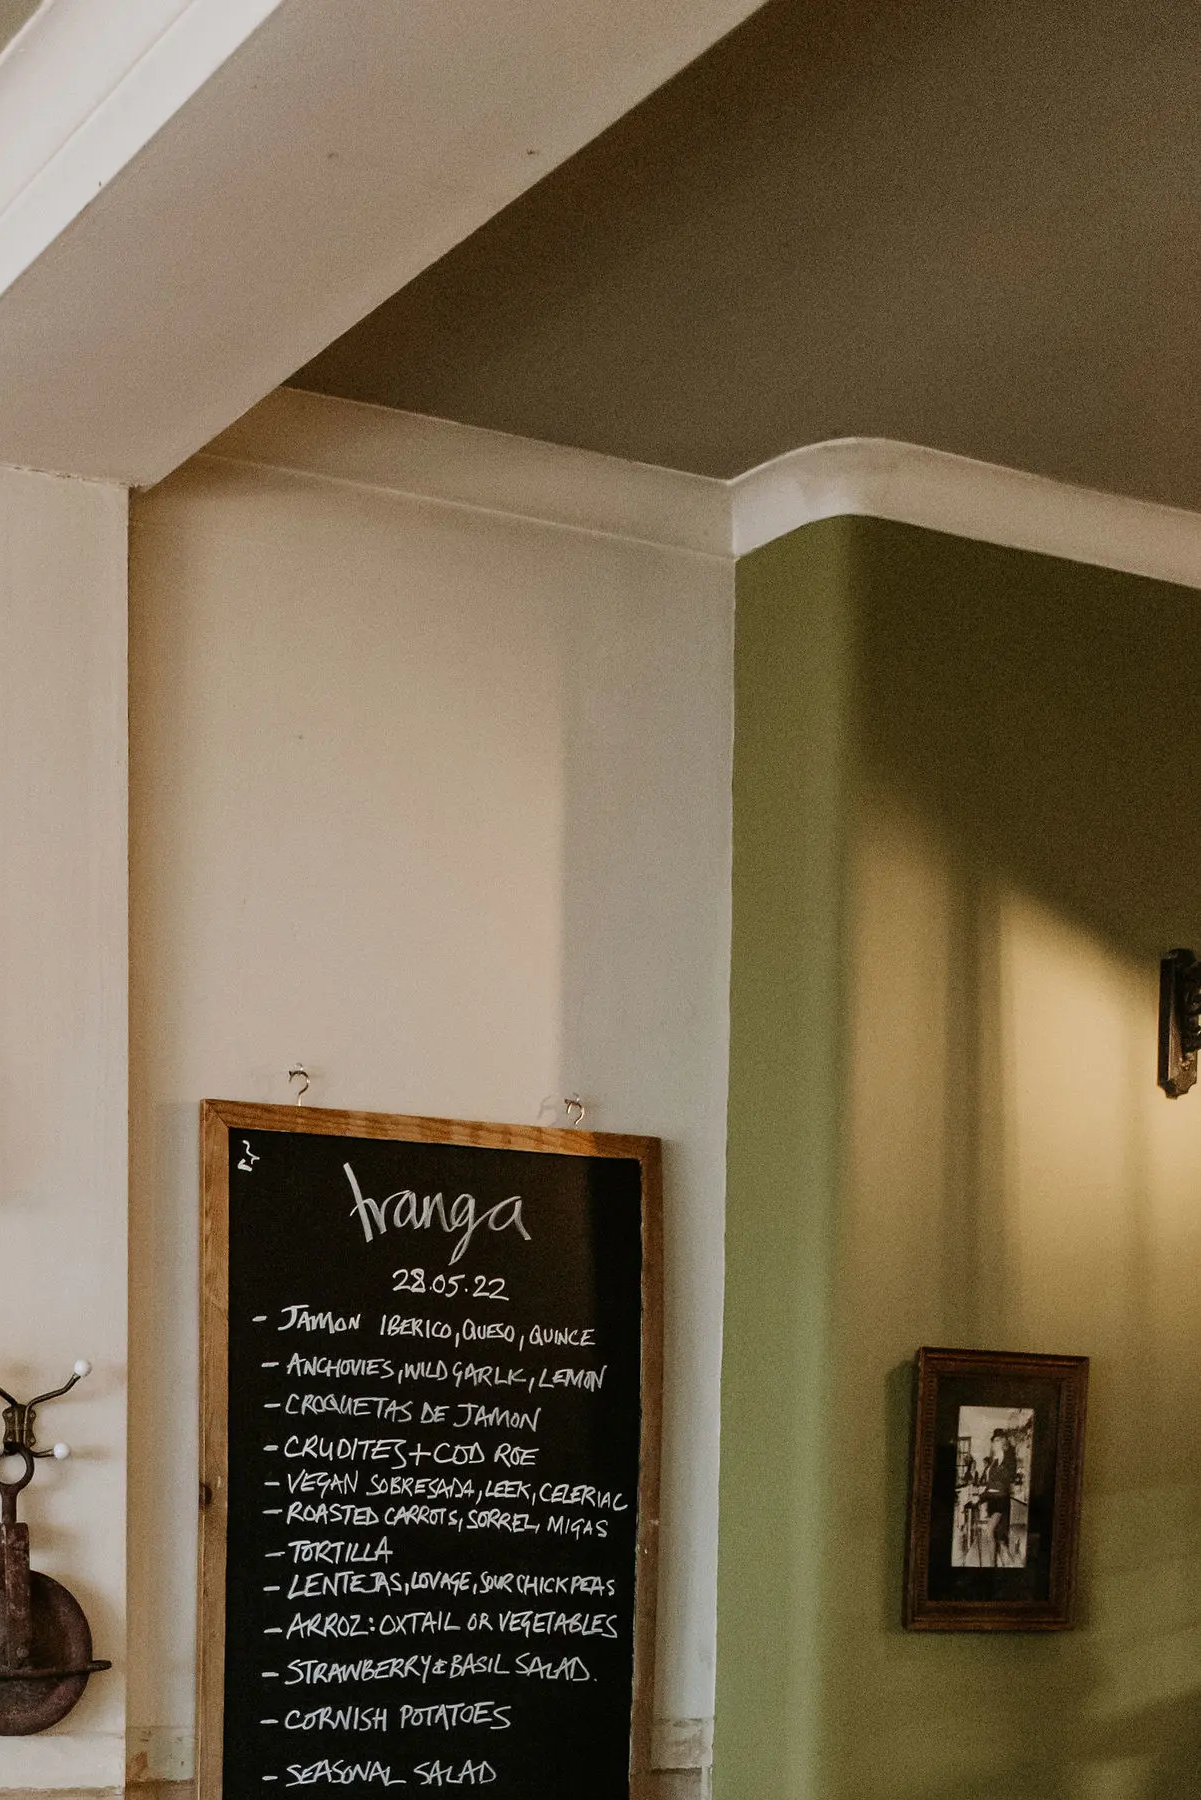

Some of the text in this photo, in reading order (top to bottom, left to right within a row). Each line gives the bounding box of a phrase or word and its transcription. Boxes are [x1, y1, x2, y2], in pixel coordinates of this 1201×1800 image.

[392, 1268, 509, 1300] 28.05.22
[278, 1304, 361, 1334] JAMON
[529, 1324, 596, 1346] QUINCE
[404, 1360, 448, 1381] WILD
[538, 1364, 607, 1392] LEMON
[285, 1393, 541, 1432] CROQUETAS DE JAMON
[284, 1434, 407, 1470] CRUDITES
[433, 1441, 485, 1465] COD
[494, 1443, 540, 1468] ROE
[287, 1468, 359, 1499] VEGAN
[539, 1482, 628, 1512] CELERIAC
[286, 1501, 379, 1526] ROASTED
[547, 1515, 609, 1540] MIGAS
[288, 1536, 393, 1564] TORTILLA
[479, 1571, 514, 1593] SOUR
[379, 1611, 461, 1636] OXTAIL
[467, 1612, 493, 1631] OR
[499, 1610, 618, 1638] VEGETABLES
[284, 1655, 432, 1685] STRAWBERRY
[449, 1653, 510, 1679] BASIL
[284, 1701, 512, 1732] CORNISH POTATOES
[285, 1759, 497, 1787] SEASONAL SALAD
